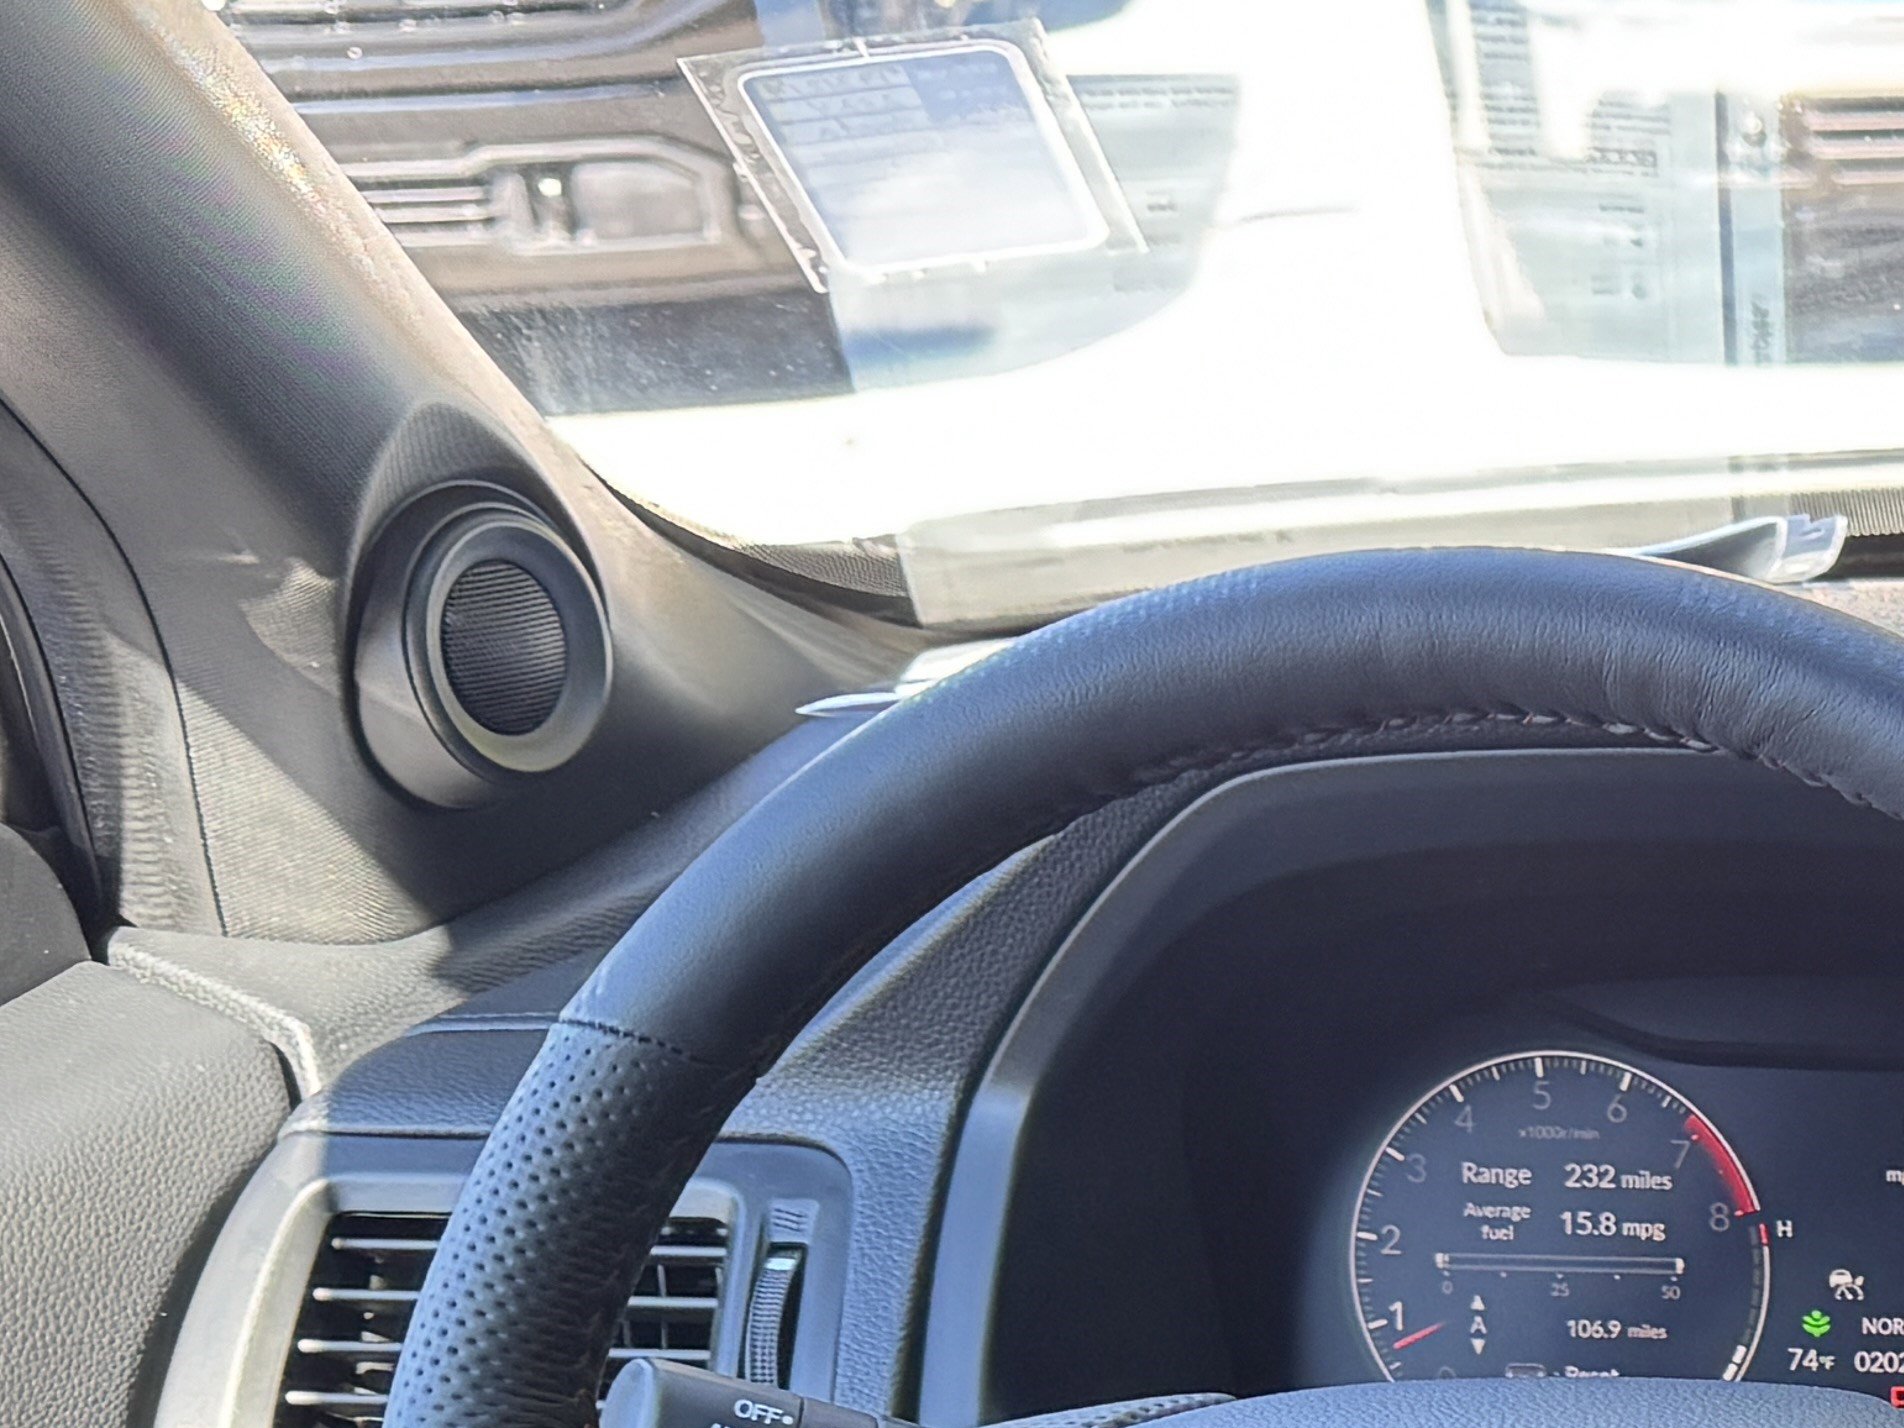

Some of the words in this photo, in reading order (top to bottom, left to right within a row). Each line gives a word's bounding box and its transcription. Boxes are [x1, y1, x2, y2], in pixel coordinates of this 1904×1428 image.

[1532, 1082, 1551, 1109] 5
[1455, 1105, 1475, 1132] 4
[1607, 1096, 1627, 1123] 6
[1670, 1140, 1690, 1169] 7
[1406, 1154, 1427, 1183] 3
[1462, 1162, 1532, 1188] Range
[1565, 1163, 1616, 1188] 232
[1620, 1170, 1672, 1190] miles
[1463, 1202, 1531, 1221] Average
[1709, 1203, 1729, 1232] 8
[1481, 1225, 1513, 1240] fuel
[1560, 1211, 1616, 1235] 15.8
[1622, 1223, 1665, 1241] mpg
[1777, 1221, 1793, 1238] H
[1381, 1226, 1402, 1255] 2
[1441, 1281, 1453, 1294] 0
[1550, 1283, 1570, 1298] 25
[1661, 1285, 1681, 1300] 50
[1389, 1302, 1404, 1331] 1
[1471, 1316, 1487, 1334] A
[1566, 1319, 1621, 1338] 106.9
[1628, 1324, 1667, 1339] miles
[734, 1400, 781, 1425] OFF
